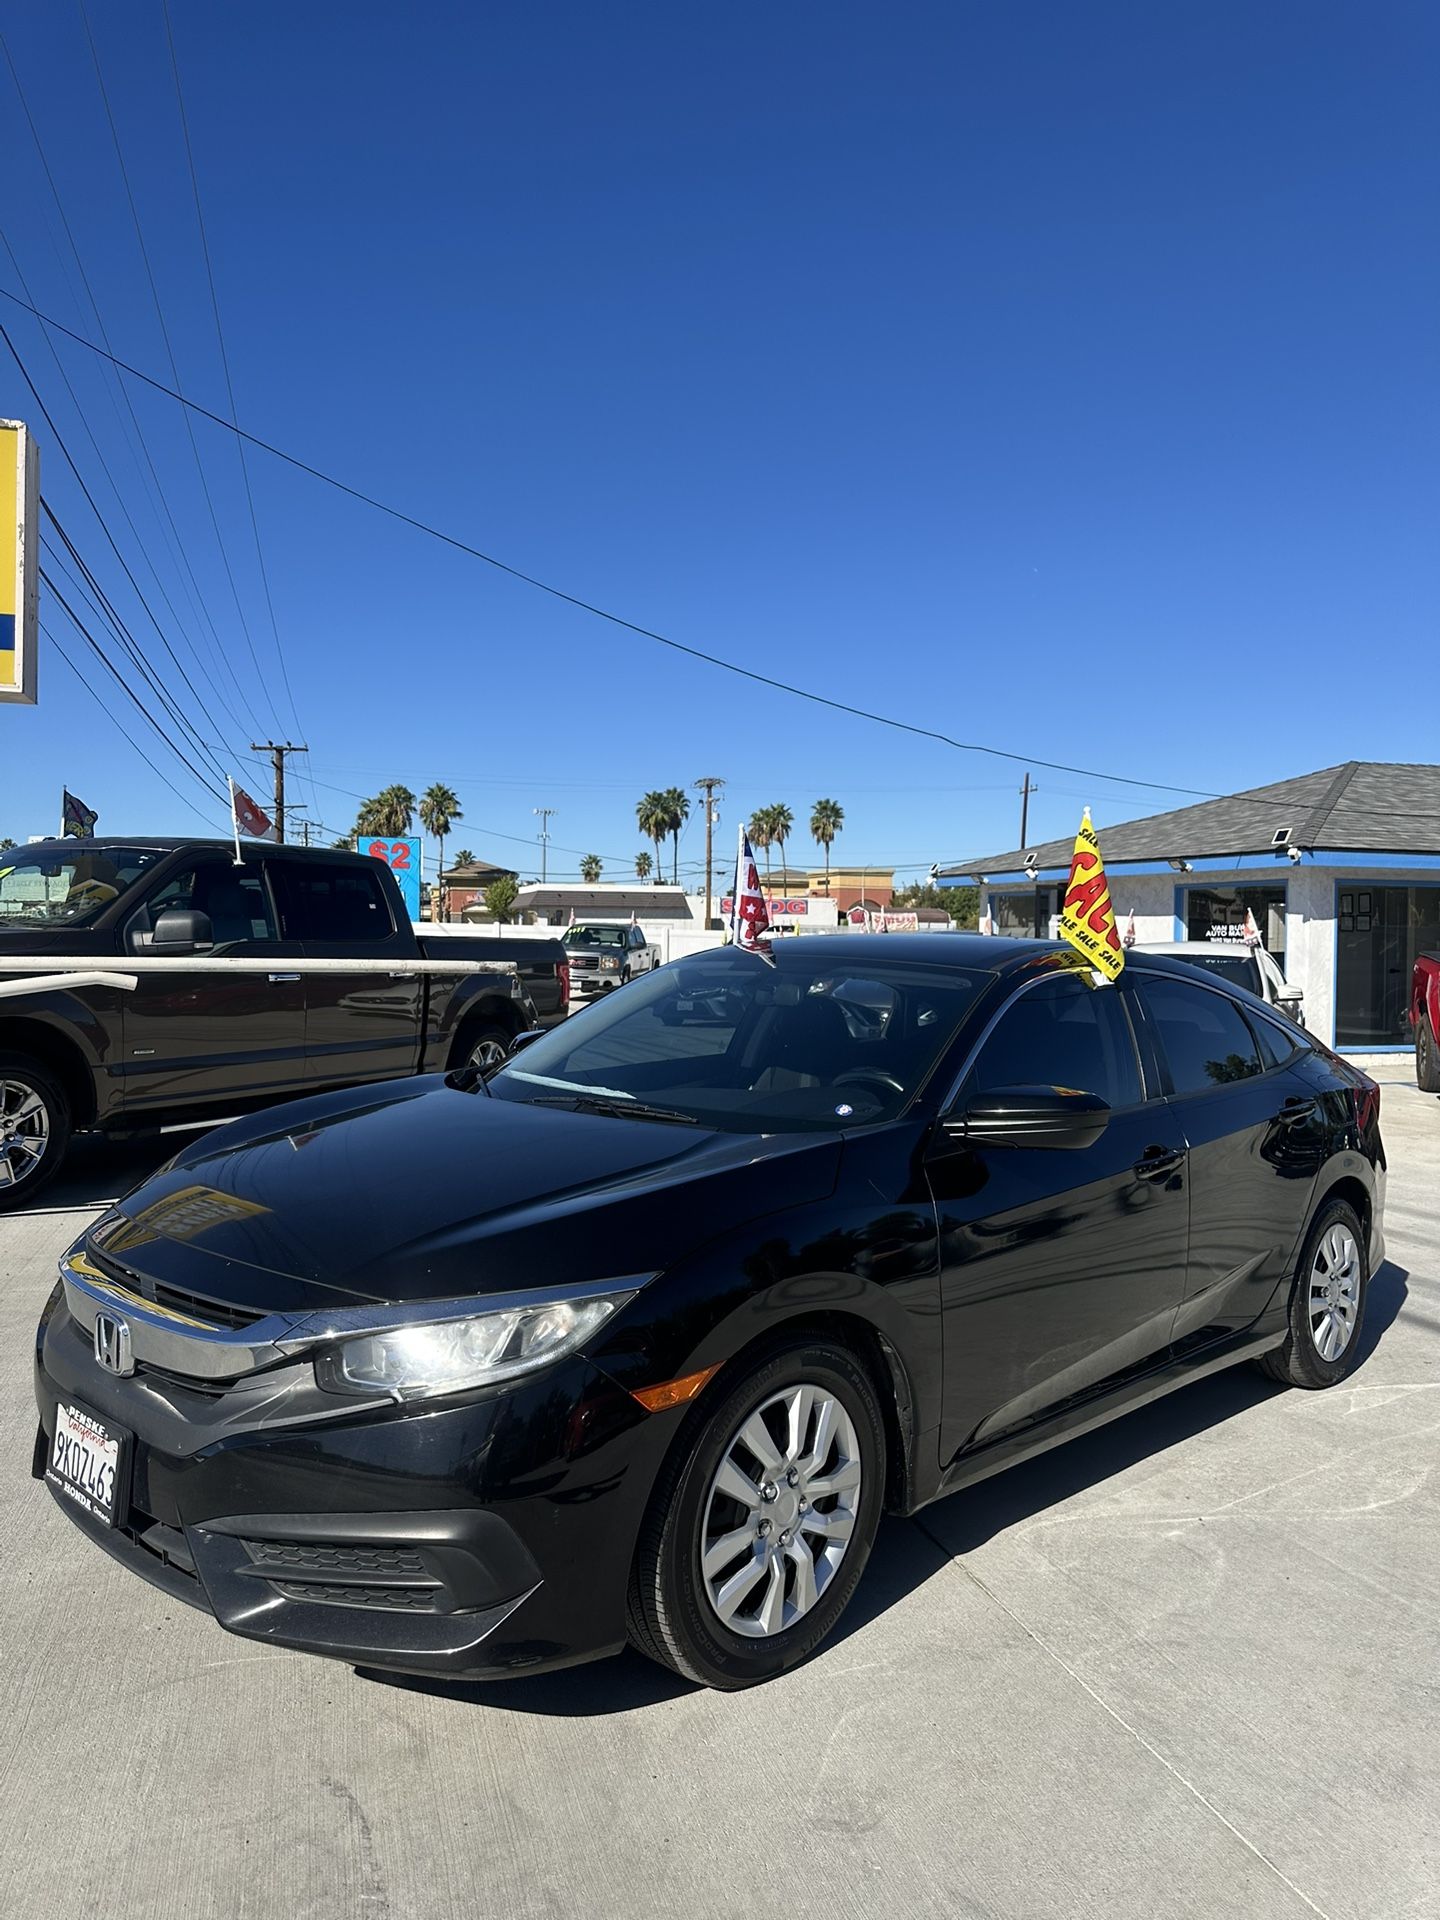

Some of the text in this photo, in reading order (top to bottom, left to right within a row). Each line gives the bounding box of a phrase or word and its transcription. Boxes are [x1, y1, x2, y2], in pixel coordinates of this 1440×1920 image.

[369, 840, 411, 869] $2
[1075, 930, 1100, 950] SALE
[1099, 949, 1121, 971] SALE
[68, 1405, 106, 1437] PENSKE
[63, 1481, 92, 1511] HONDA
[93, 1505, 111, 1525] Ontario
